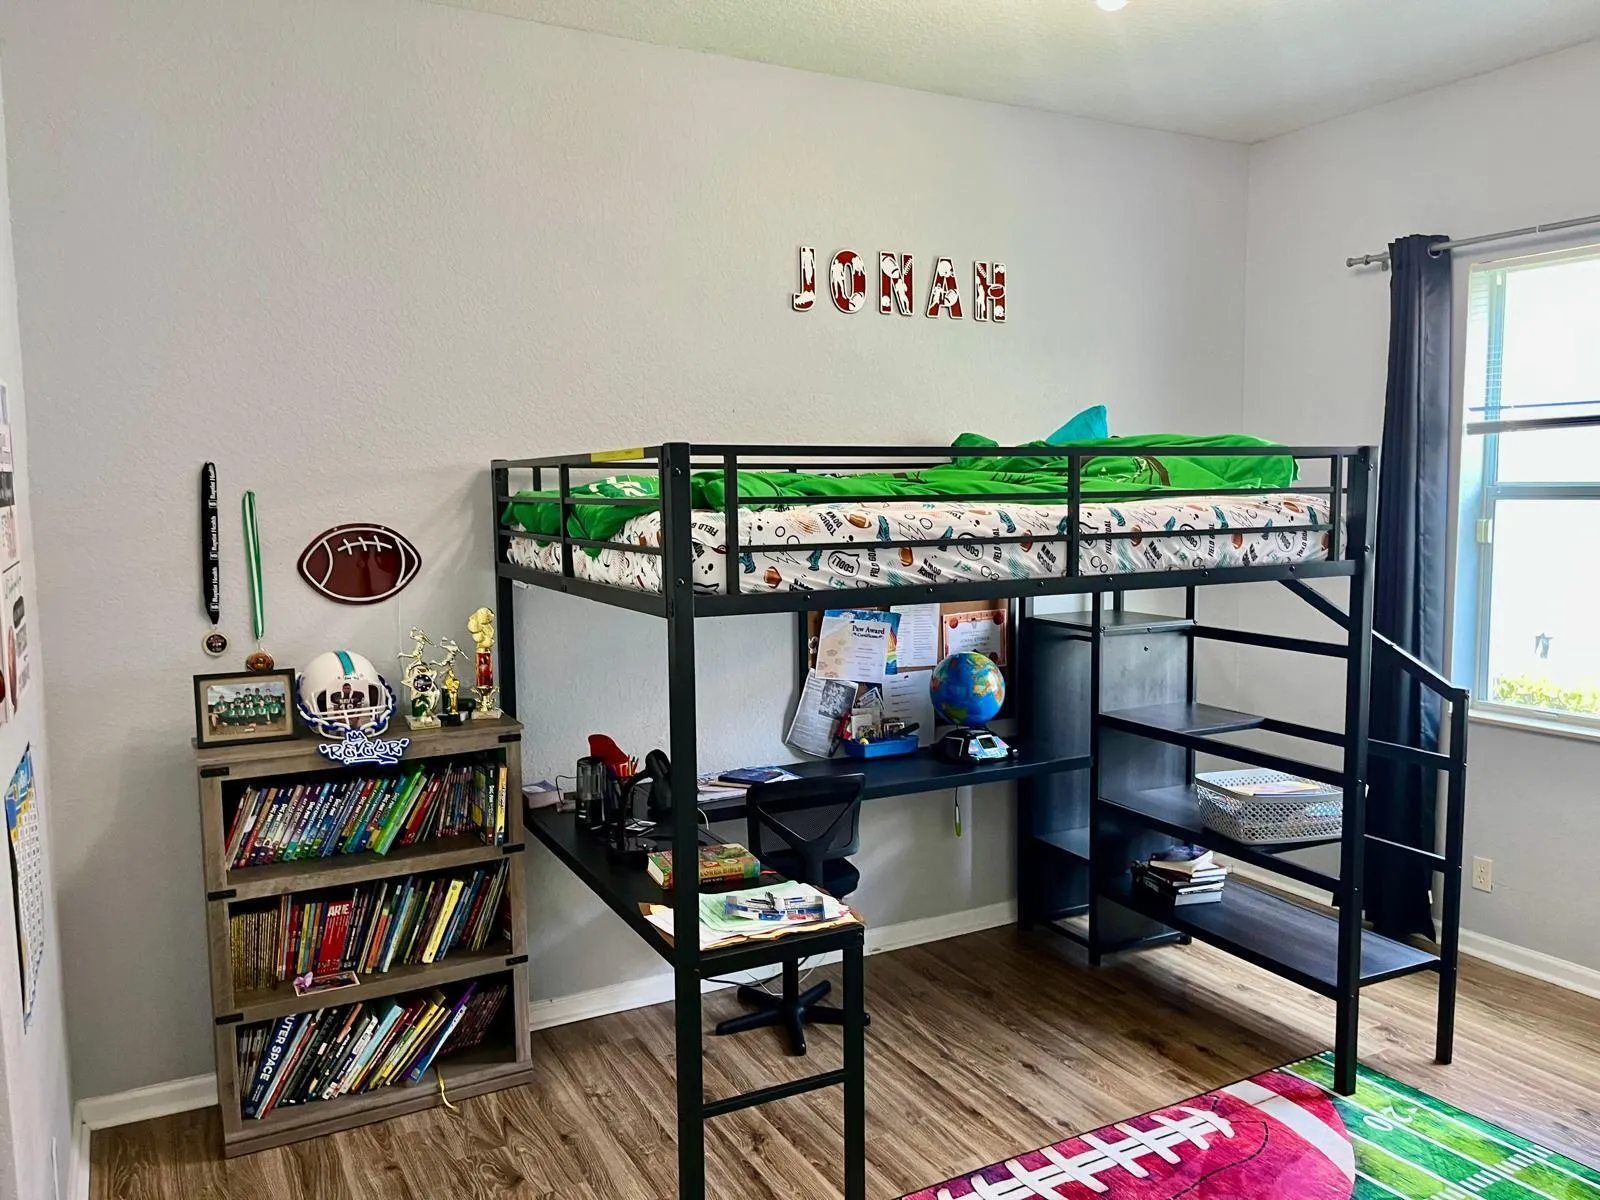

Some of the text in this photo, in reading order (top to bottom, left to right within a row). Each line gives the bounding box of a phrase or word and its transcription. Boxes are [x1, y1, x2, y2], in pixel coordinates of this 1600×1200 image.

[792, 246, 1007, 322] JONAH
[698, 523, 719, 537] FIELD
[993, 546, 1002, 563] FIELD
[1207, 539, 1215, 558] FIELD
[832, 554, 855, 574] COOL!
[869, 563, 881, 578] FIELD
[260, 1045, 282, 1081] SPACE
